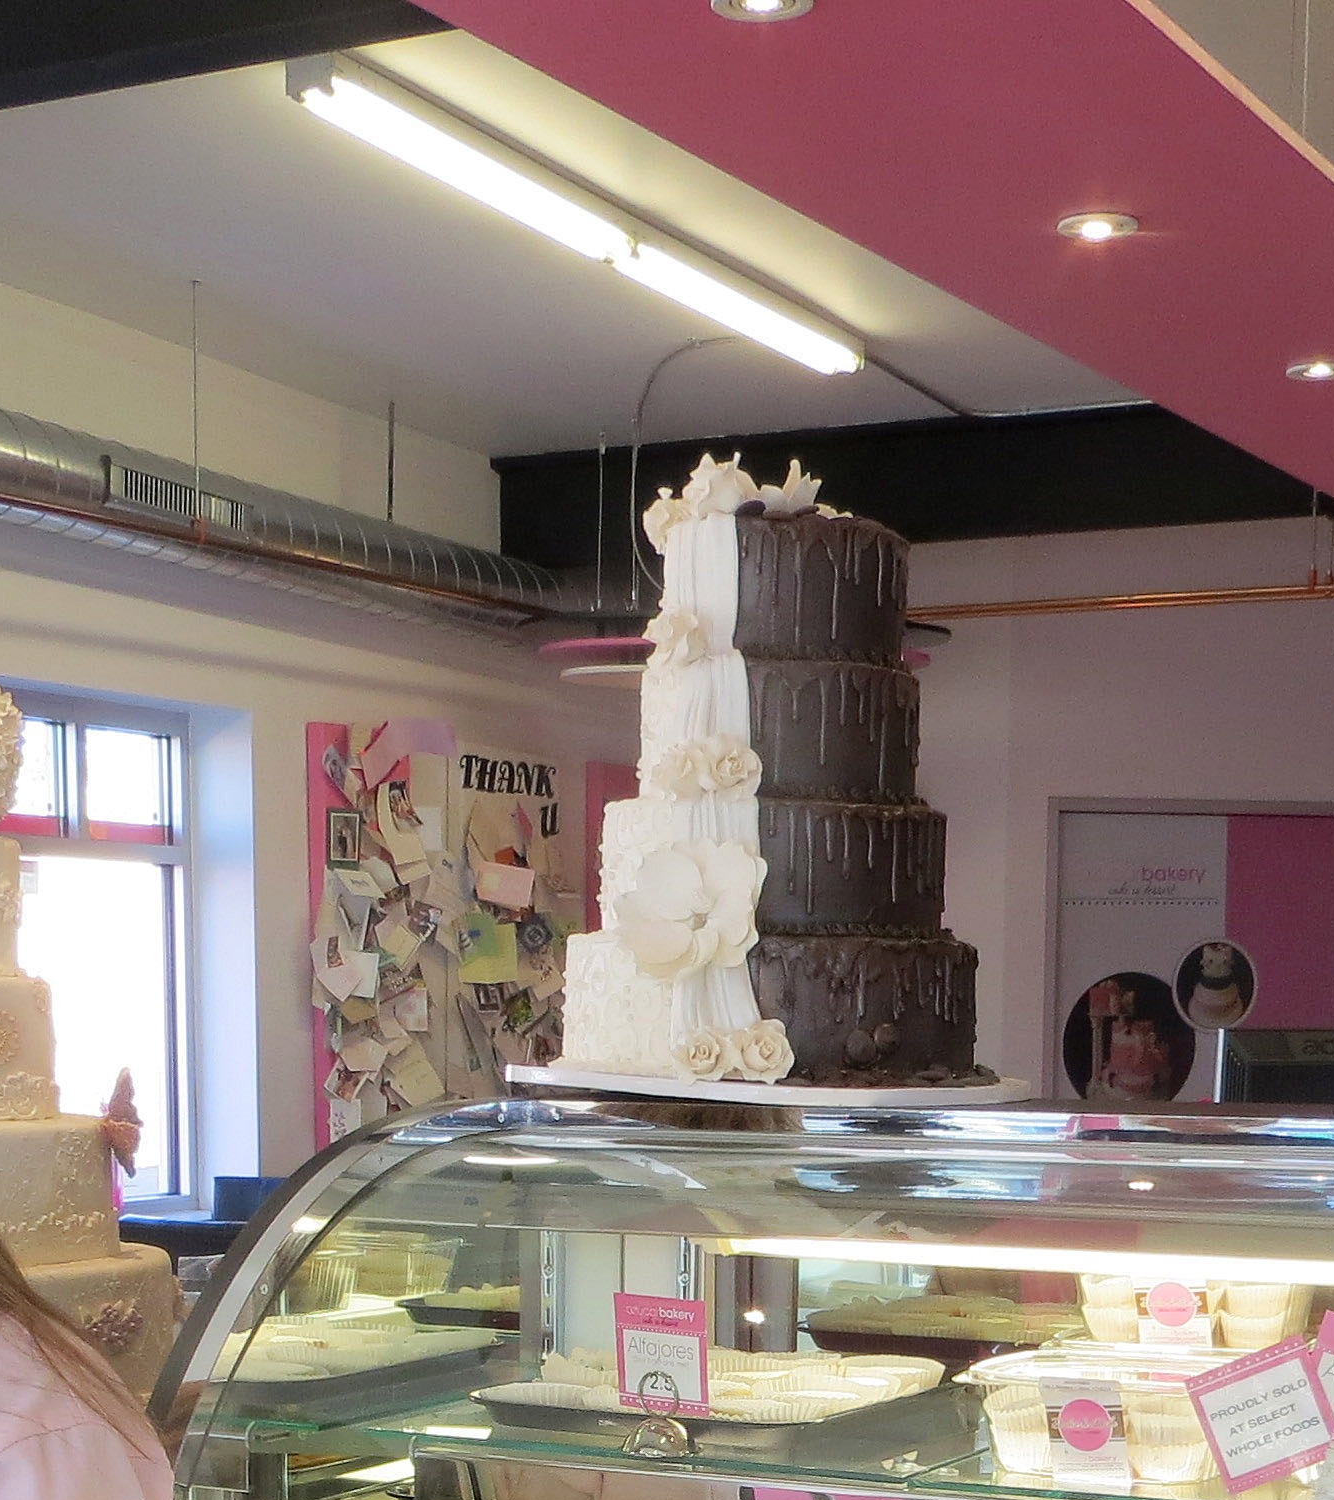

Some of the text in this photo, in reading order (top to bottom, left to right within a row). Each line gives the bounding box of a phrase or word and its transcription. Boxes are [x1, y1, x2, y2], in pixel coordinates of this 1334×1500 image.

[459, 754, 557, 799] THANK
[540, 802, 560, 839] U
[1141, 865, 1207, 884] bakery
[627, 1336, 694, 1361] Alfajores
[649, 1373, 673, 1392] 2.5
[1209, 1378, 1308, 1422] PROUDLY SOLD
[1225, 1415, 1320, 1458] WHOLE FOODS
[1229, 1402, 1297, 1438] AT SELECT
